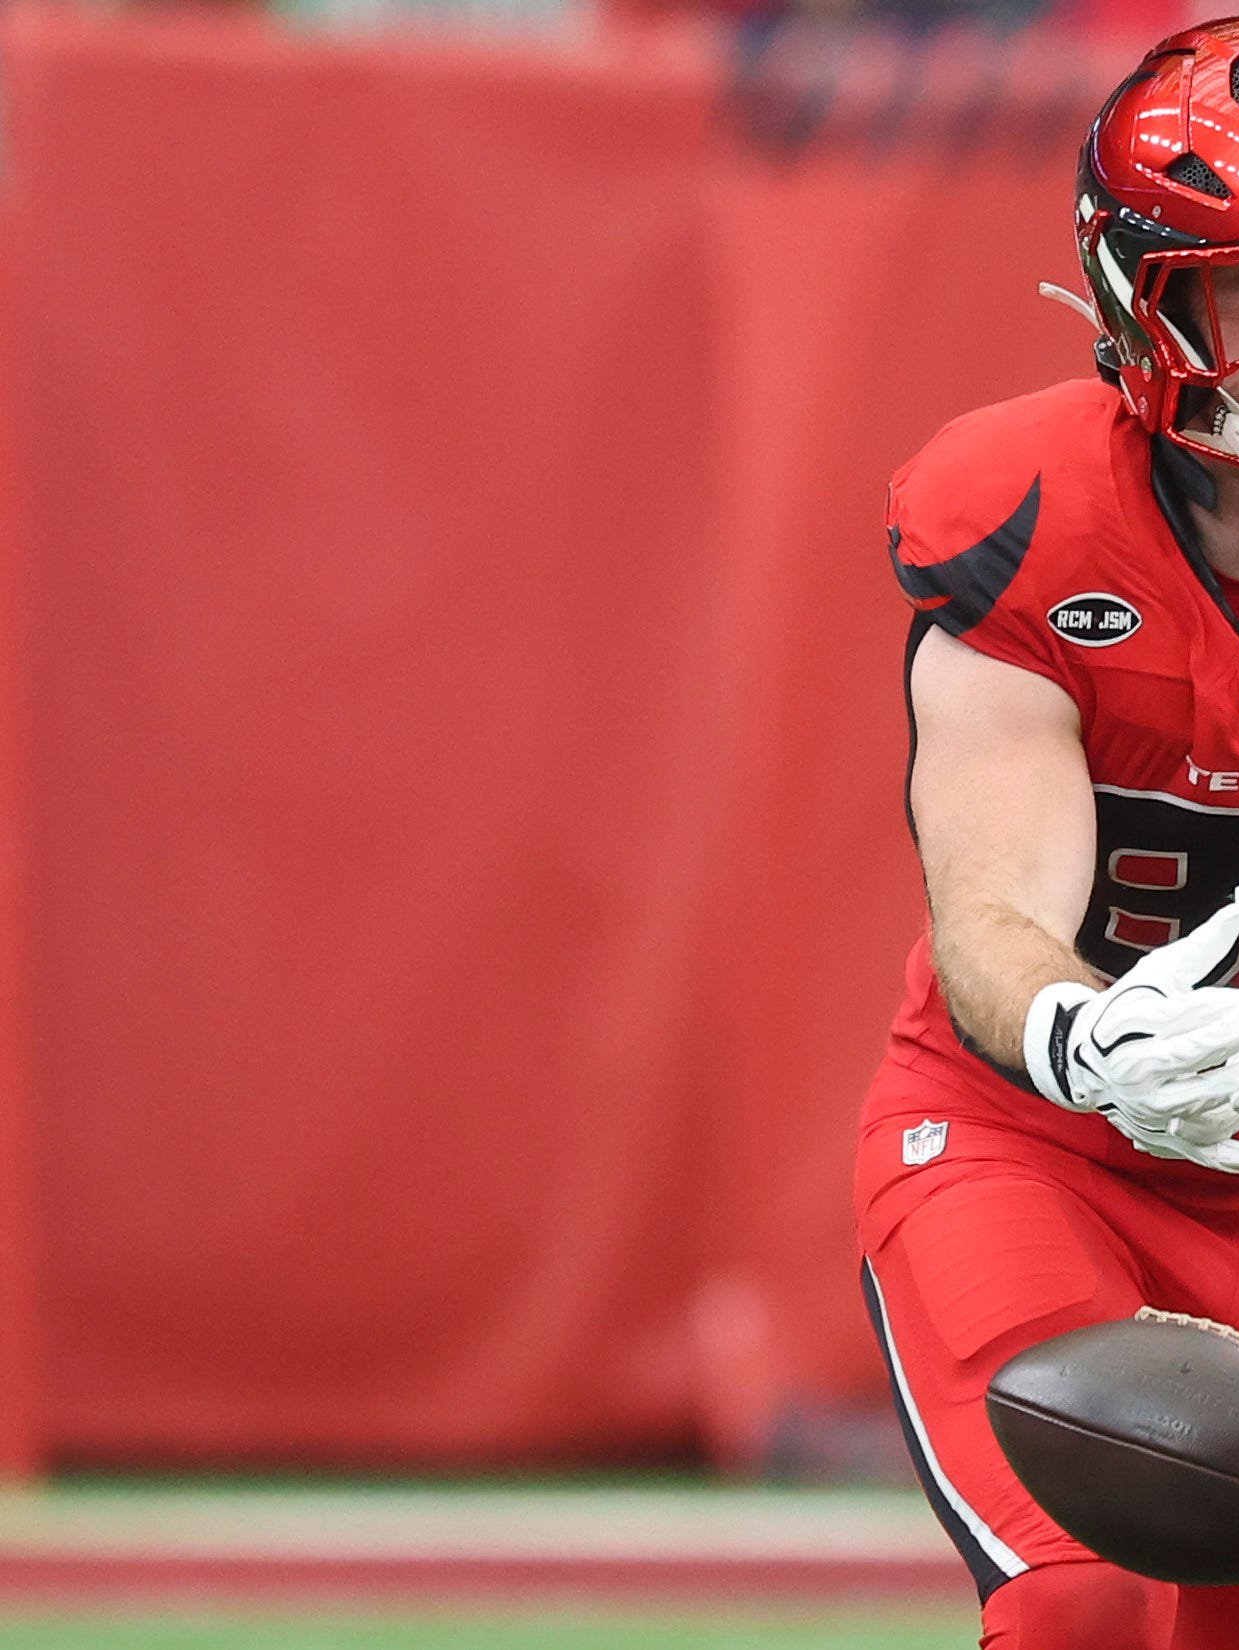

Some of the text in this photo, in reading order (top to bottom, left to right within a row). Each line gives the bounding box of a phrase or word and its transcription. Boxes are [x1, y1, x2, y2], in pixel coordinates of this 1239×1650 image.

[1056, 610, 1132, 631] RCM JSM
[911, 1138, 937, 1157] NFL
